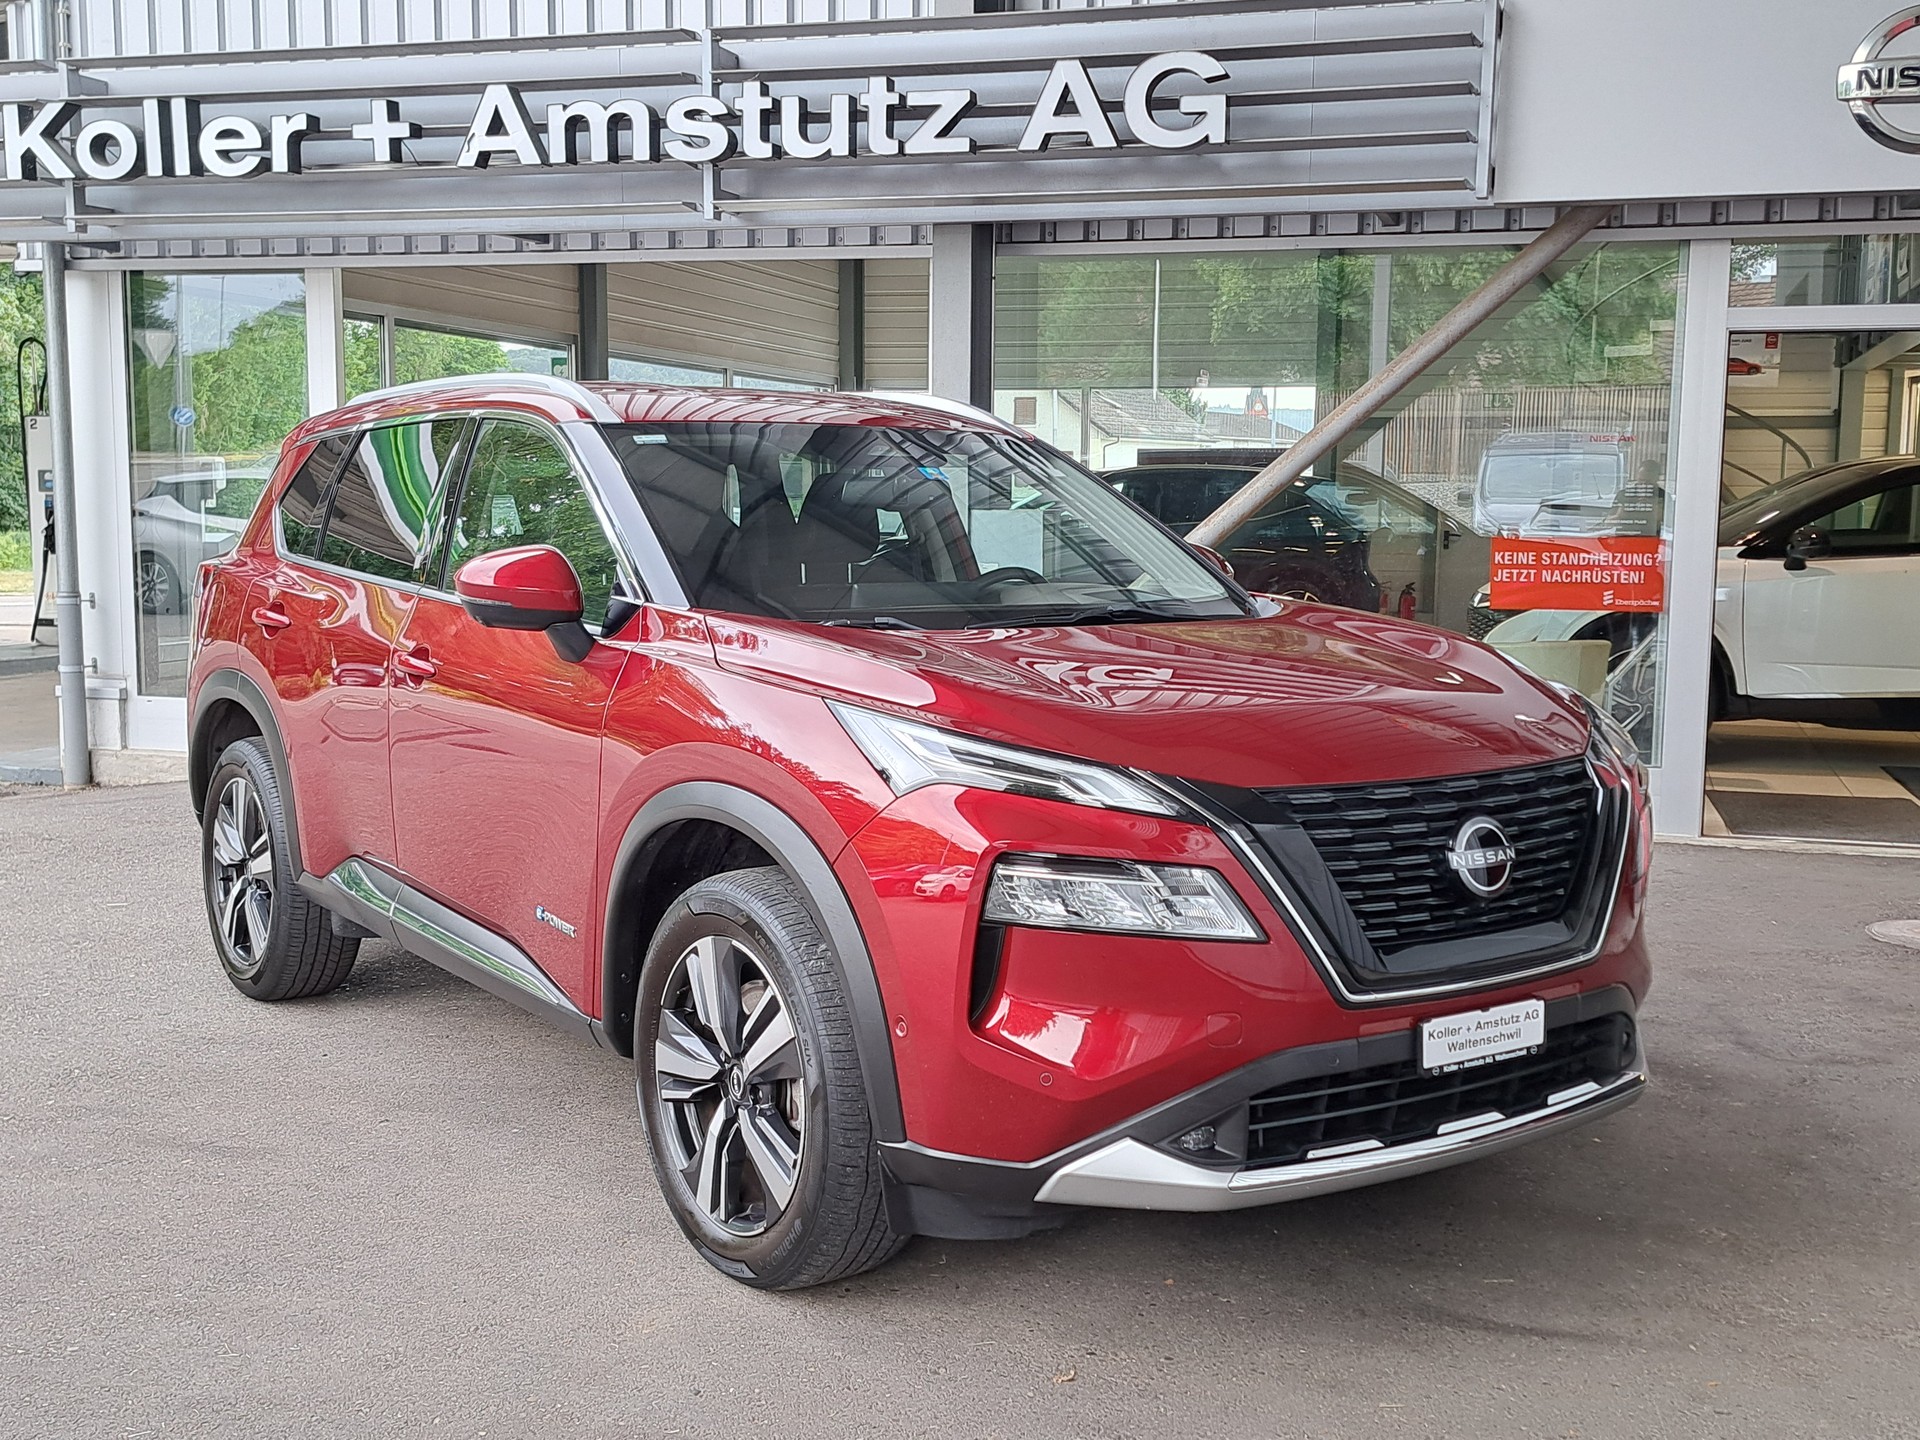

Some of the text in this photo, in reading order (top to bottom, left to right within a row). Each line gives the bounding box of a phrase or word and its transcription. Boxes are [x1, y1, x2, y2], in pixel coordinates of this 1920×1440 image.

[1855, 66, 1920, 91] NIS
[2, 51, 1231, 181] Koller + Amstutz AG
[29, 418, 38, 430] 2
[1588, 434, 1638, 443] NISSAN
[1493, 551, 1662, 567] KEINE STANDHEIZUNG?
[1493, 567, 1645, 584] JETZT NACHRÜSTEN!
[1451, 846, 1516, 867] NISSAN
[1427, 1025, 1463, 1041] Koller
[1474, 1012, 1522, 1032] Amstutz
[1523, 1008, 1540, 1021] AG
[1446, 1027, 1522, 1053] Waltenschwil
[760, 1224, 803, 1270] Hanko
